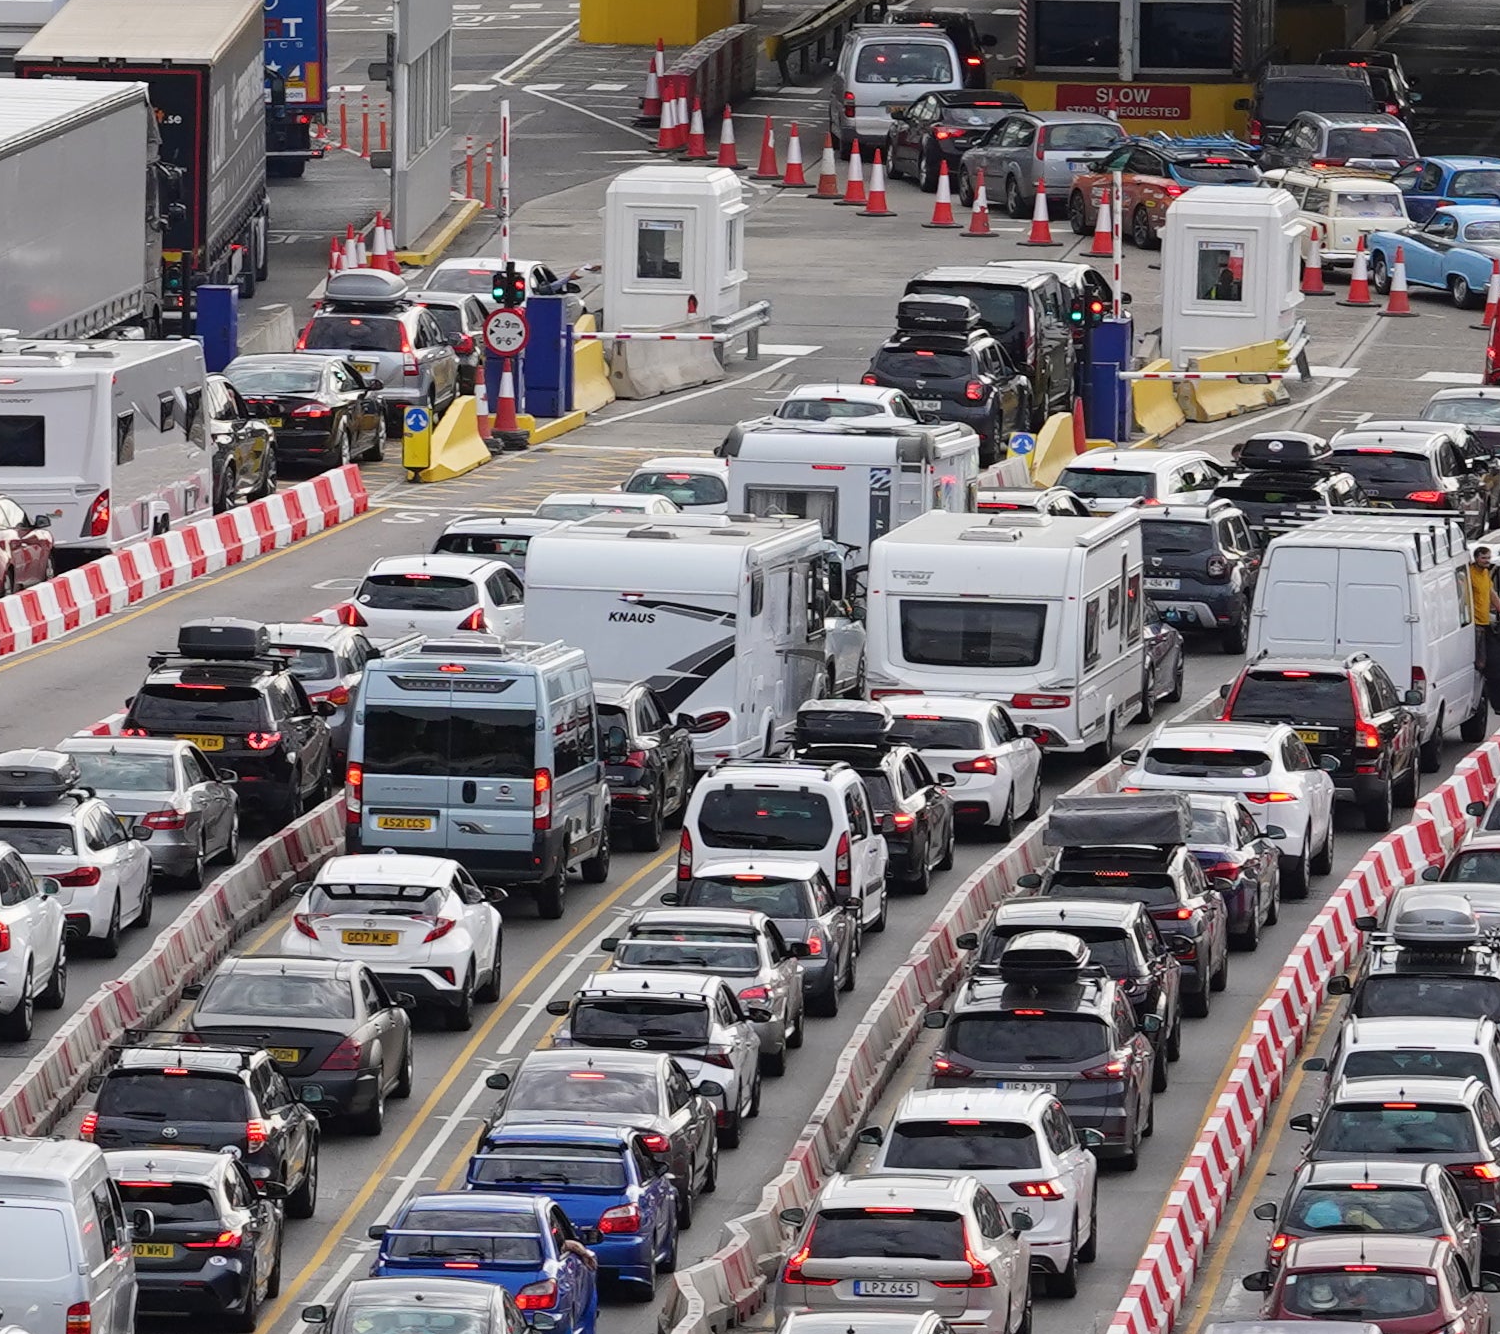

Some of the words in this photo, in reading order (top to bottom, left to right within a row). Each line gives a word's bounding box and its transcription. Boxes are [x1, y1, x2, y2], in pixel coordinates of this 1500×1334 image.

[1095, 87, 1152, 104] SLOW
[608, 611, 656, 624] KNAUS
[863, 1282, 886, 1294] LPZ
[891, 1283, 914, 1295] 645
